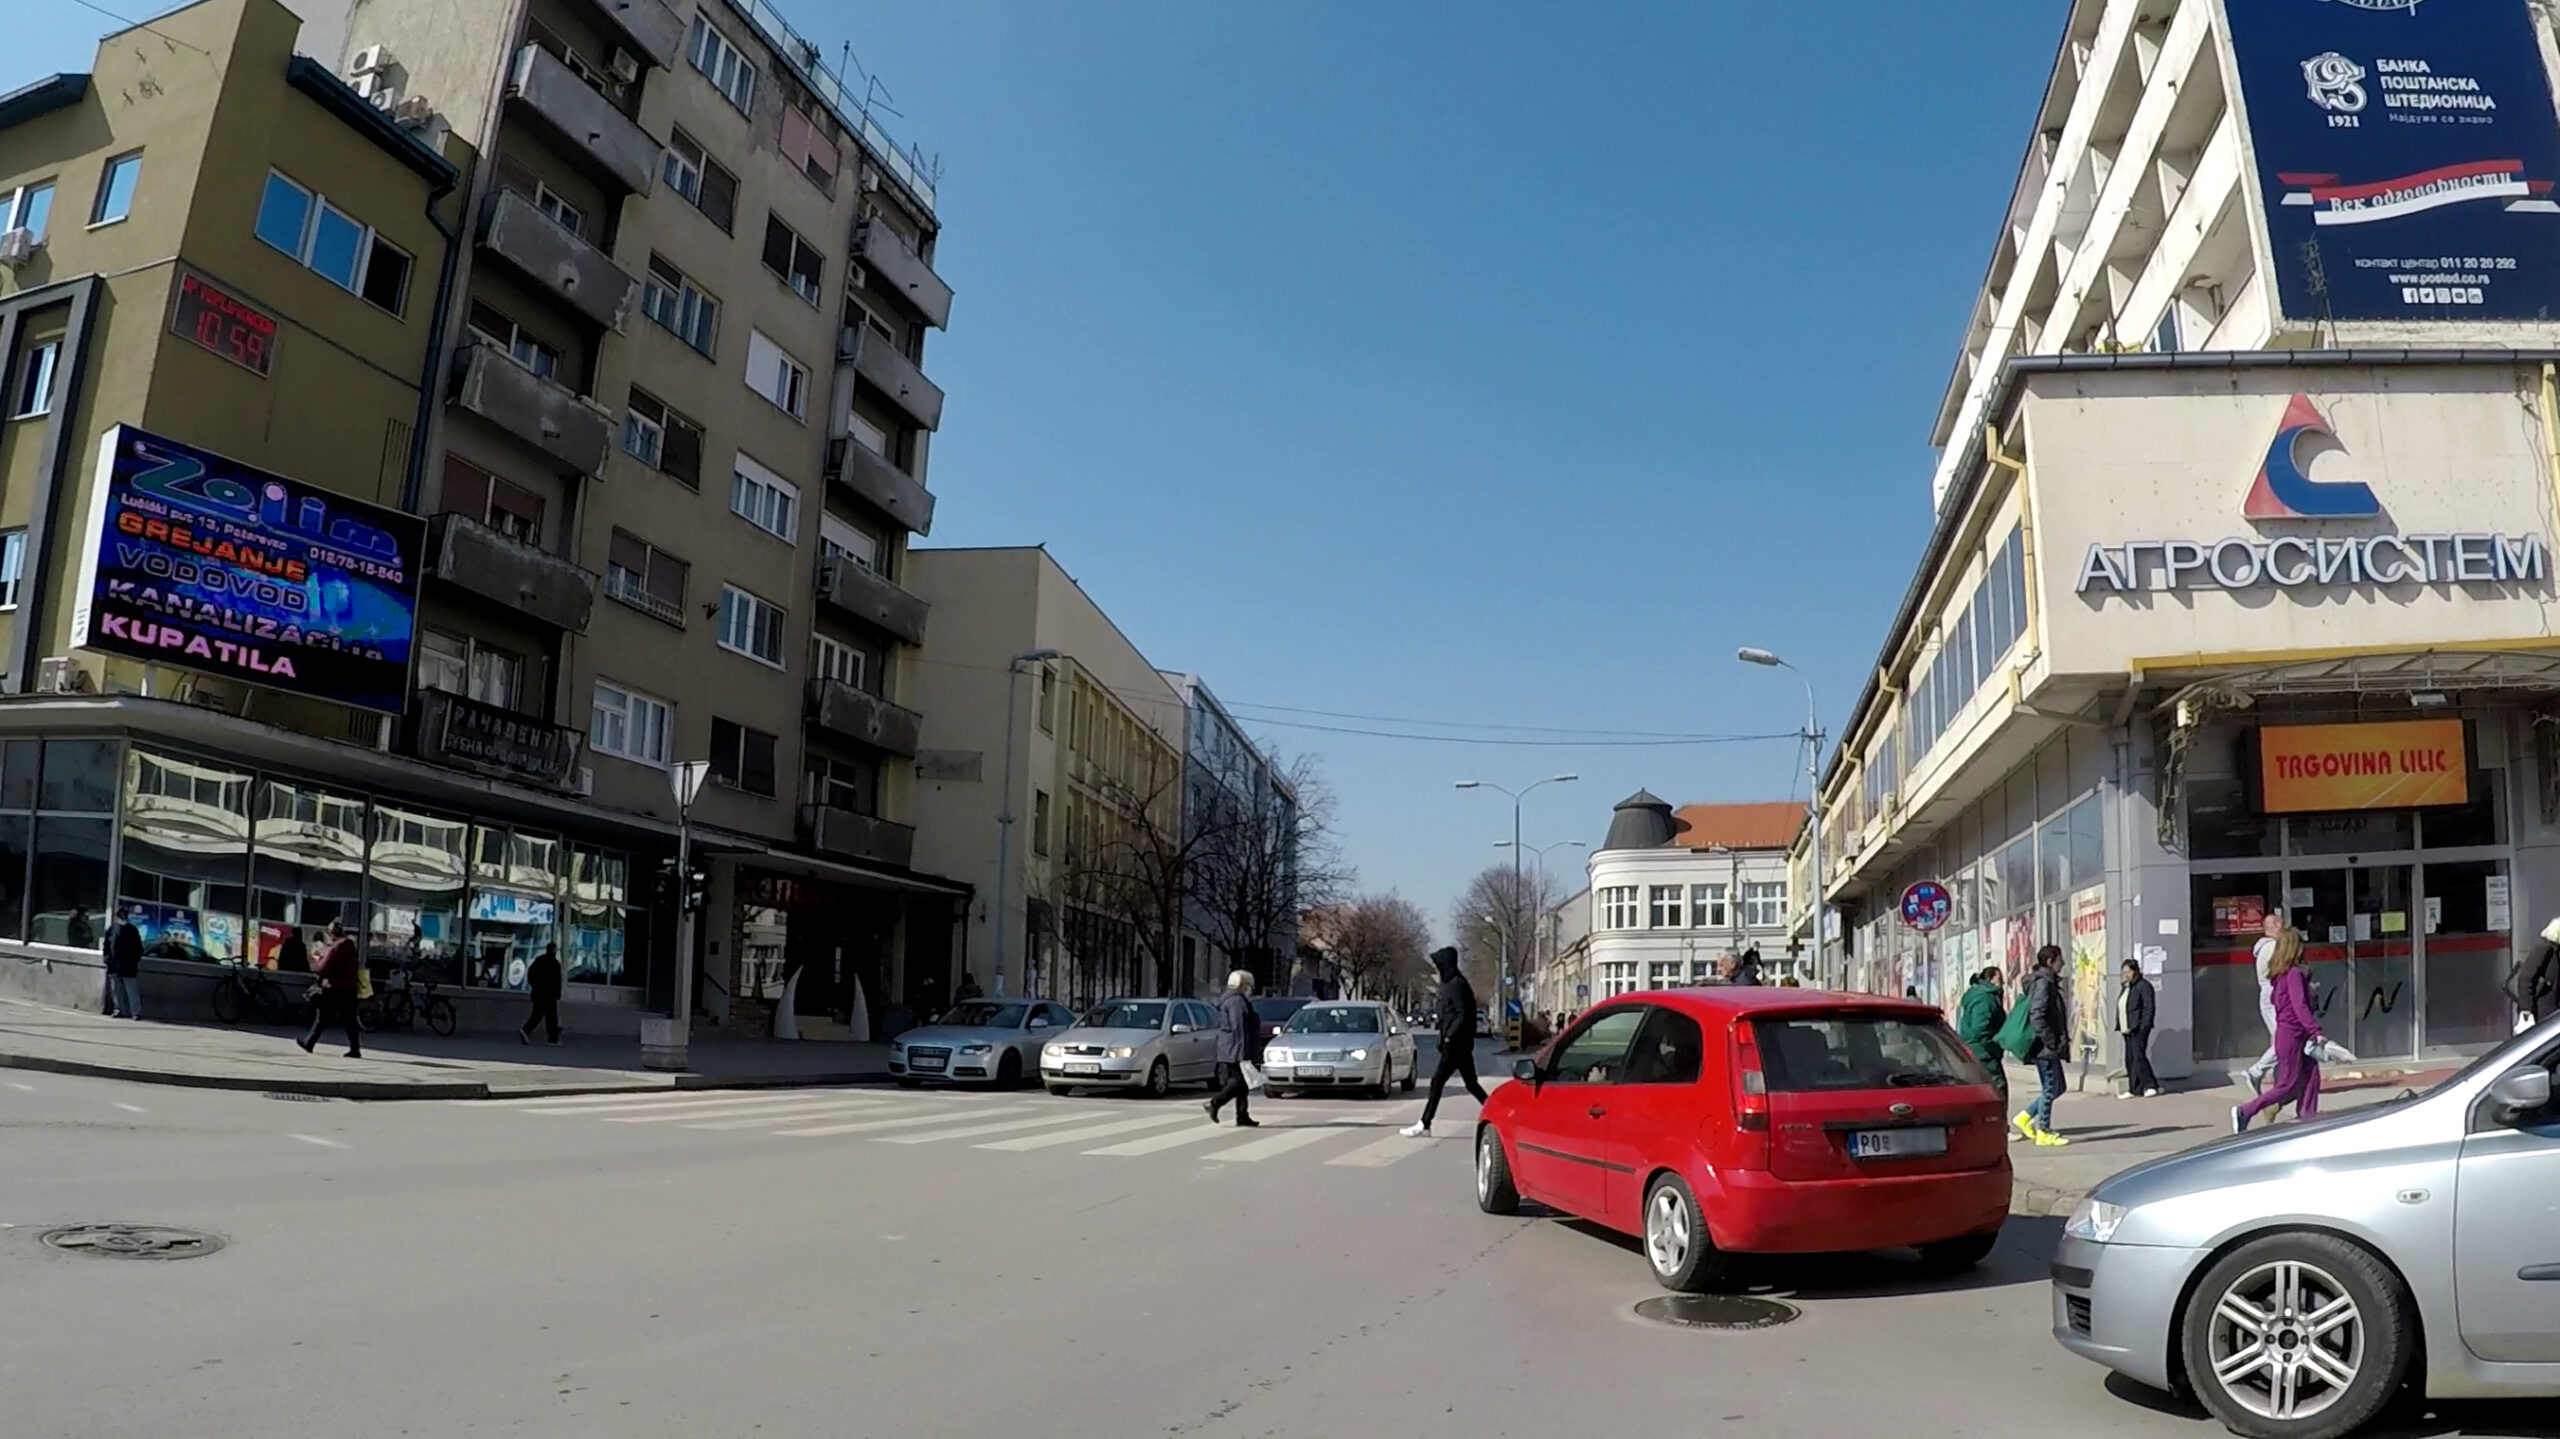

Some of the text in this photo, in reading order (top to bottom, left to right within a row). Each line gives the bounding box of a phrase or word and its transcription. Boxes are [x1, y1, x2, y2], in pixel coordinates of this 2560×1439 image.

[2376, 59, 2431, 73] БАНКА
[2380, 75, 2480, 91] ПОШТАНСКА
[2383, 93, 2496, 111] ШТЕДИОНИЦА
[2327, 115, 2360, 128] 1921
[2329, 171, 2513, 214] Век одговорности
[2354, 257, 2517, 270] контакт центар 011 20 20 292
[2389, 273, 2490, 285] www.posted.co.rs
[117, 512, 307, 582] GREJANJE
[2075, 532, 2544, 594] АГРОСИСТЕМ
[116, 543, 308, 613] VODOVOD
[101, 613, 296, 679] KUPATILA
